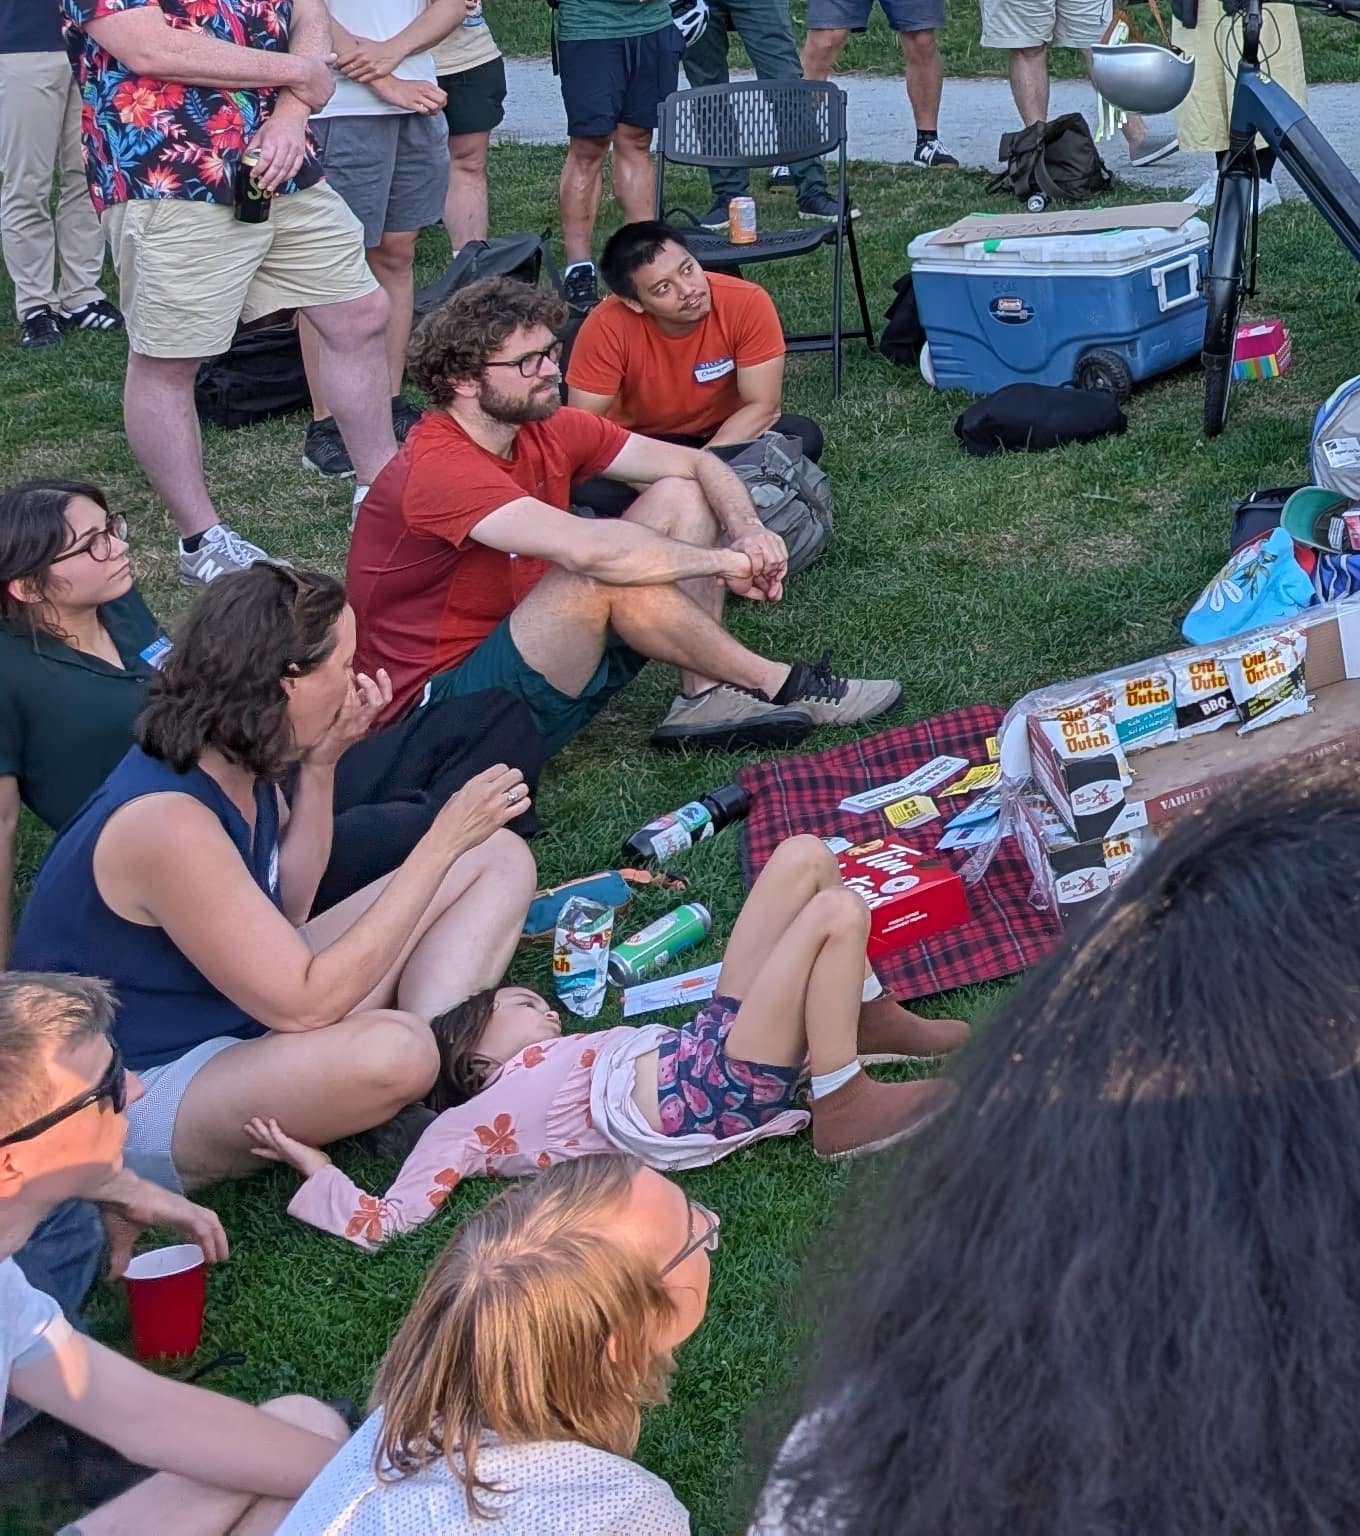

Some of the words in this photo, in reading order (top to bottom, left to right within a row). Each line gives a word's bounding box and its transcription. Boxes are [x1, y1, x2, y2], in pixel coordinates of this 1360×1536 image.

[196, 558, 225, 584] N
[1189, 659, 1216, 675] Old
[1241, 650, 1266, 669] Old
[1246, 660, 1286, 684] Dutch
[1191, 674, 1227, 691] Dutc
[1126, 689, 1170, 707] Dutch
[1200, 696, 1230, 716] BBQ
[1062, 719, 1089, 737] Old
[1066, 733, 1110, 753] Dutch
[856, 843, 923, 875] Tim
[1103, 842, 1132, 859] tch
